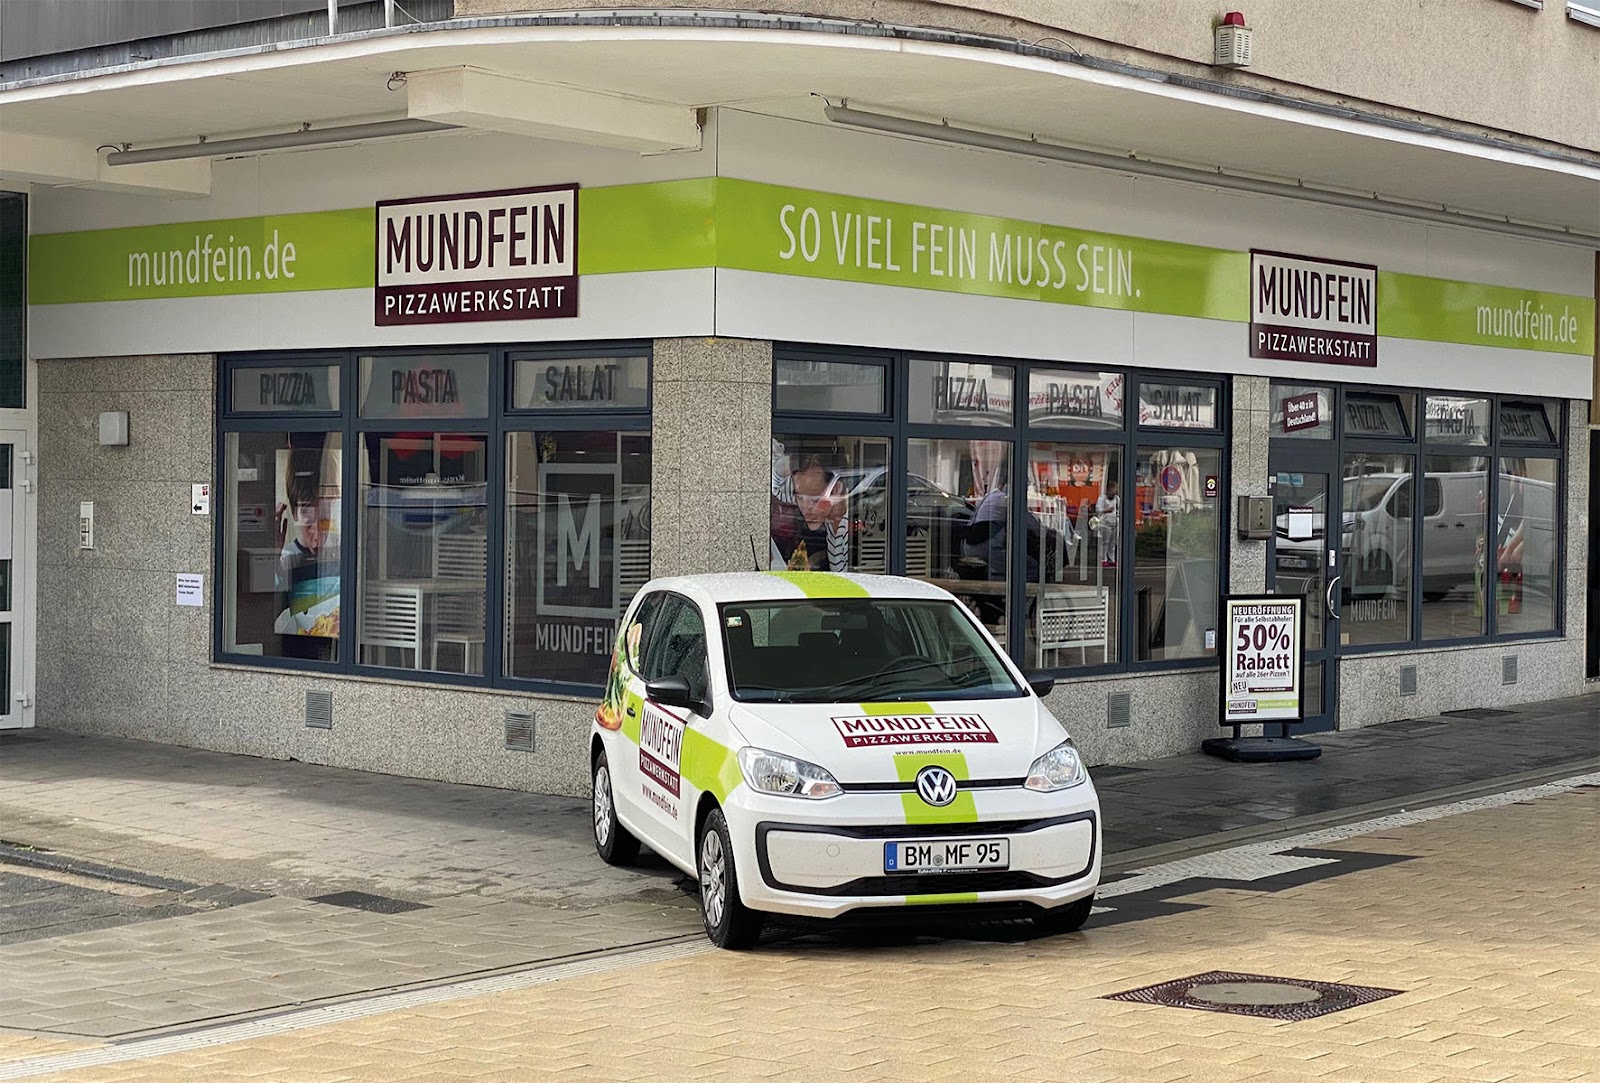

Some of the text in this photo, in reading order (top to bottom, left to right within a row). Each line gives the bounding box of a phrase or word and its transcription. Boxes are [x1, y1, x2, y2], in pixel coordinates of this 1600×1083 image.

[386, 203, 565, 274] MUNDFEIN
[779, 204, 1141, 298] SO VIEL FEIN MUSS SEIN.
[127, 230, 297, 288] mundfein.de
[385, 286, 565, 316] PIZZAWERKSTATT
[1258, 264, 1371, 326] MUNDFEIN
[1476, 300, 1577, 345] mundfein.de
[1258, 332, 1371, 360] PIZZAWERKSTATT
[260, 372, 316, 405] PIZZA
[392, 369, 458, 404] PASTA
[545, 364, 617, 401] SALAT
[933, 376, 989, 412] PIZZA
[1048, 383, 1102, 417] PASTA
[1153, 388, 1202, 422] SALAT
[1350, 403, 1389, 431] PIZZA
[1438, 407, 1476, 435] PASTA
[1502, 413, 1537, 437] SALAT
[1233, 605, 1295, 615] NEUERÖFFNUNG!
[1351, 600, 1397, 622] MUNDFEIN
[1237, 624, 1290, 651] 50%
[1237, 653, 1290, 671] Rabatt
[1233, 681, 1247, 691] NEU
[641, 708, 682, 766] MUNDFEIN
[842, 716, 981, 733] MUNDFEIN
[853, 733, 988, 745] PIZZAWERKSTATT
[905, 843, 1001, 866] BM MF 95
